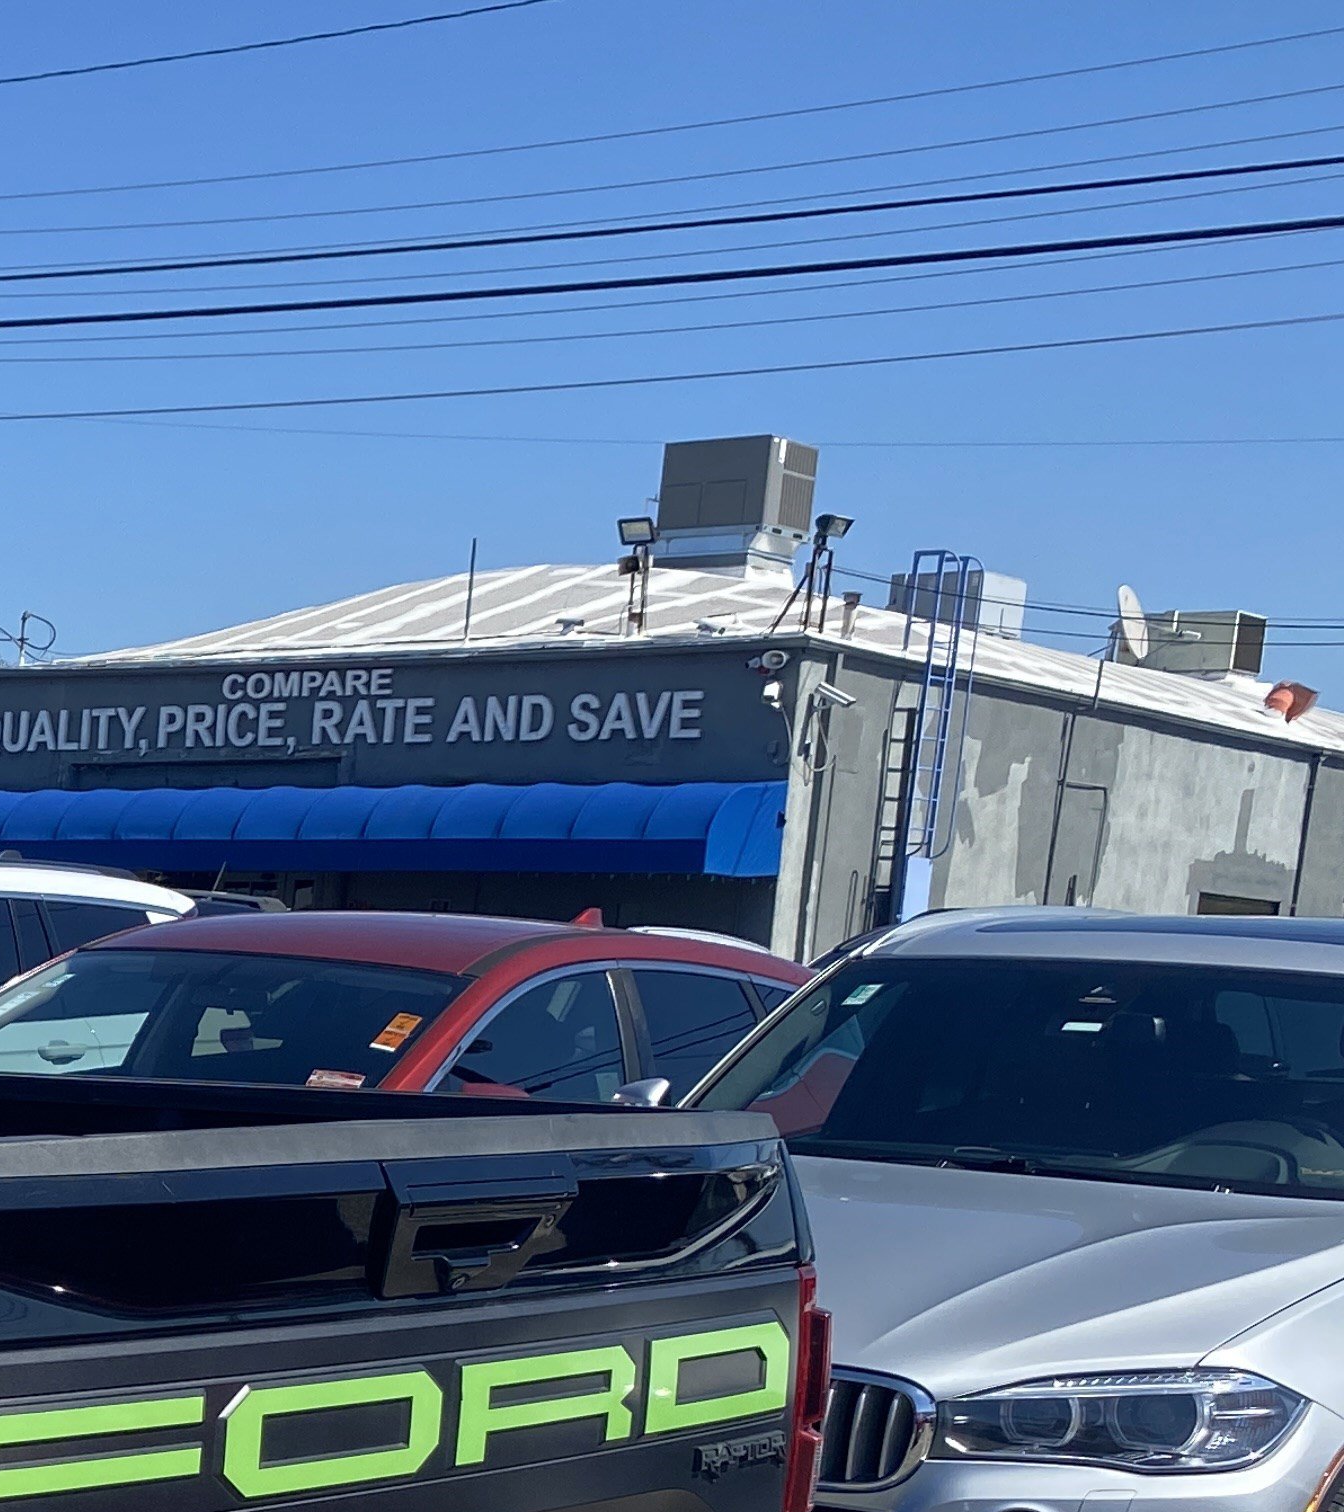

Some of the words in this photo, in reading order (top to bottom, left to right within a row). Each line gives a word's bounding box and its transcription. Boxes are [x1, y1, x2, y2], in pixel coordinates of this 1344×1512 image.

[222, 668, 395, 700] COMPARE
[157, 701, 297, 755] PRICE,
[311, 697, 436, 745] RATE
[446, 694, 555, 744] AND
[567, 689, 705, 743] SAVE
[692, 1429, 788, 1482] RAPTOR
